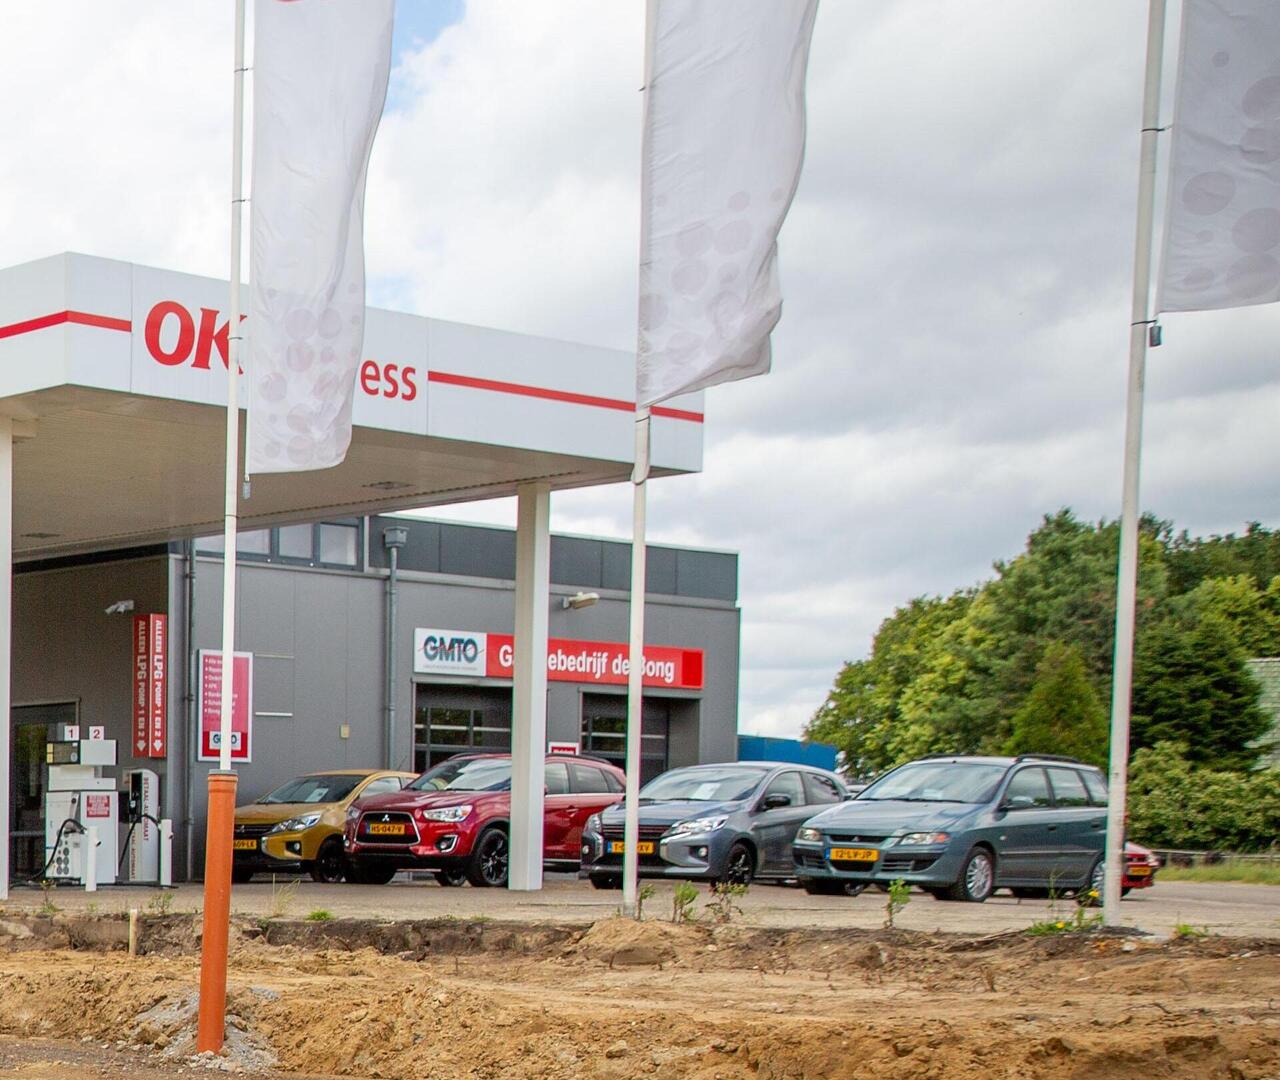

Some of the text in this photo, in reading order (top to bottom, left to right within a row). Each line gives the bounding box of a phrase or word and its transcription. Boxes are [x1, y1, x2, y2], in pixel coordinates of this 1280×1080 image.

[144, 300, 248, 375] OK
[423, 635, 478, 664] GMTO
[498, 644, 608, 679] Gebedrijf
[612, 653, 630, 675] de
[137, 654, 147, 679] LPG
[154, 654, 163, 679] LPG
[93, 729, 100, 739] 2
[213, 734, 238, 745] GO
